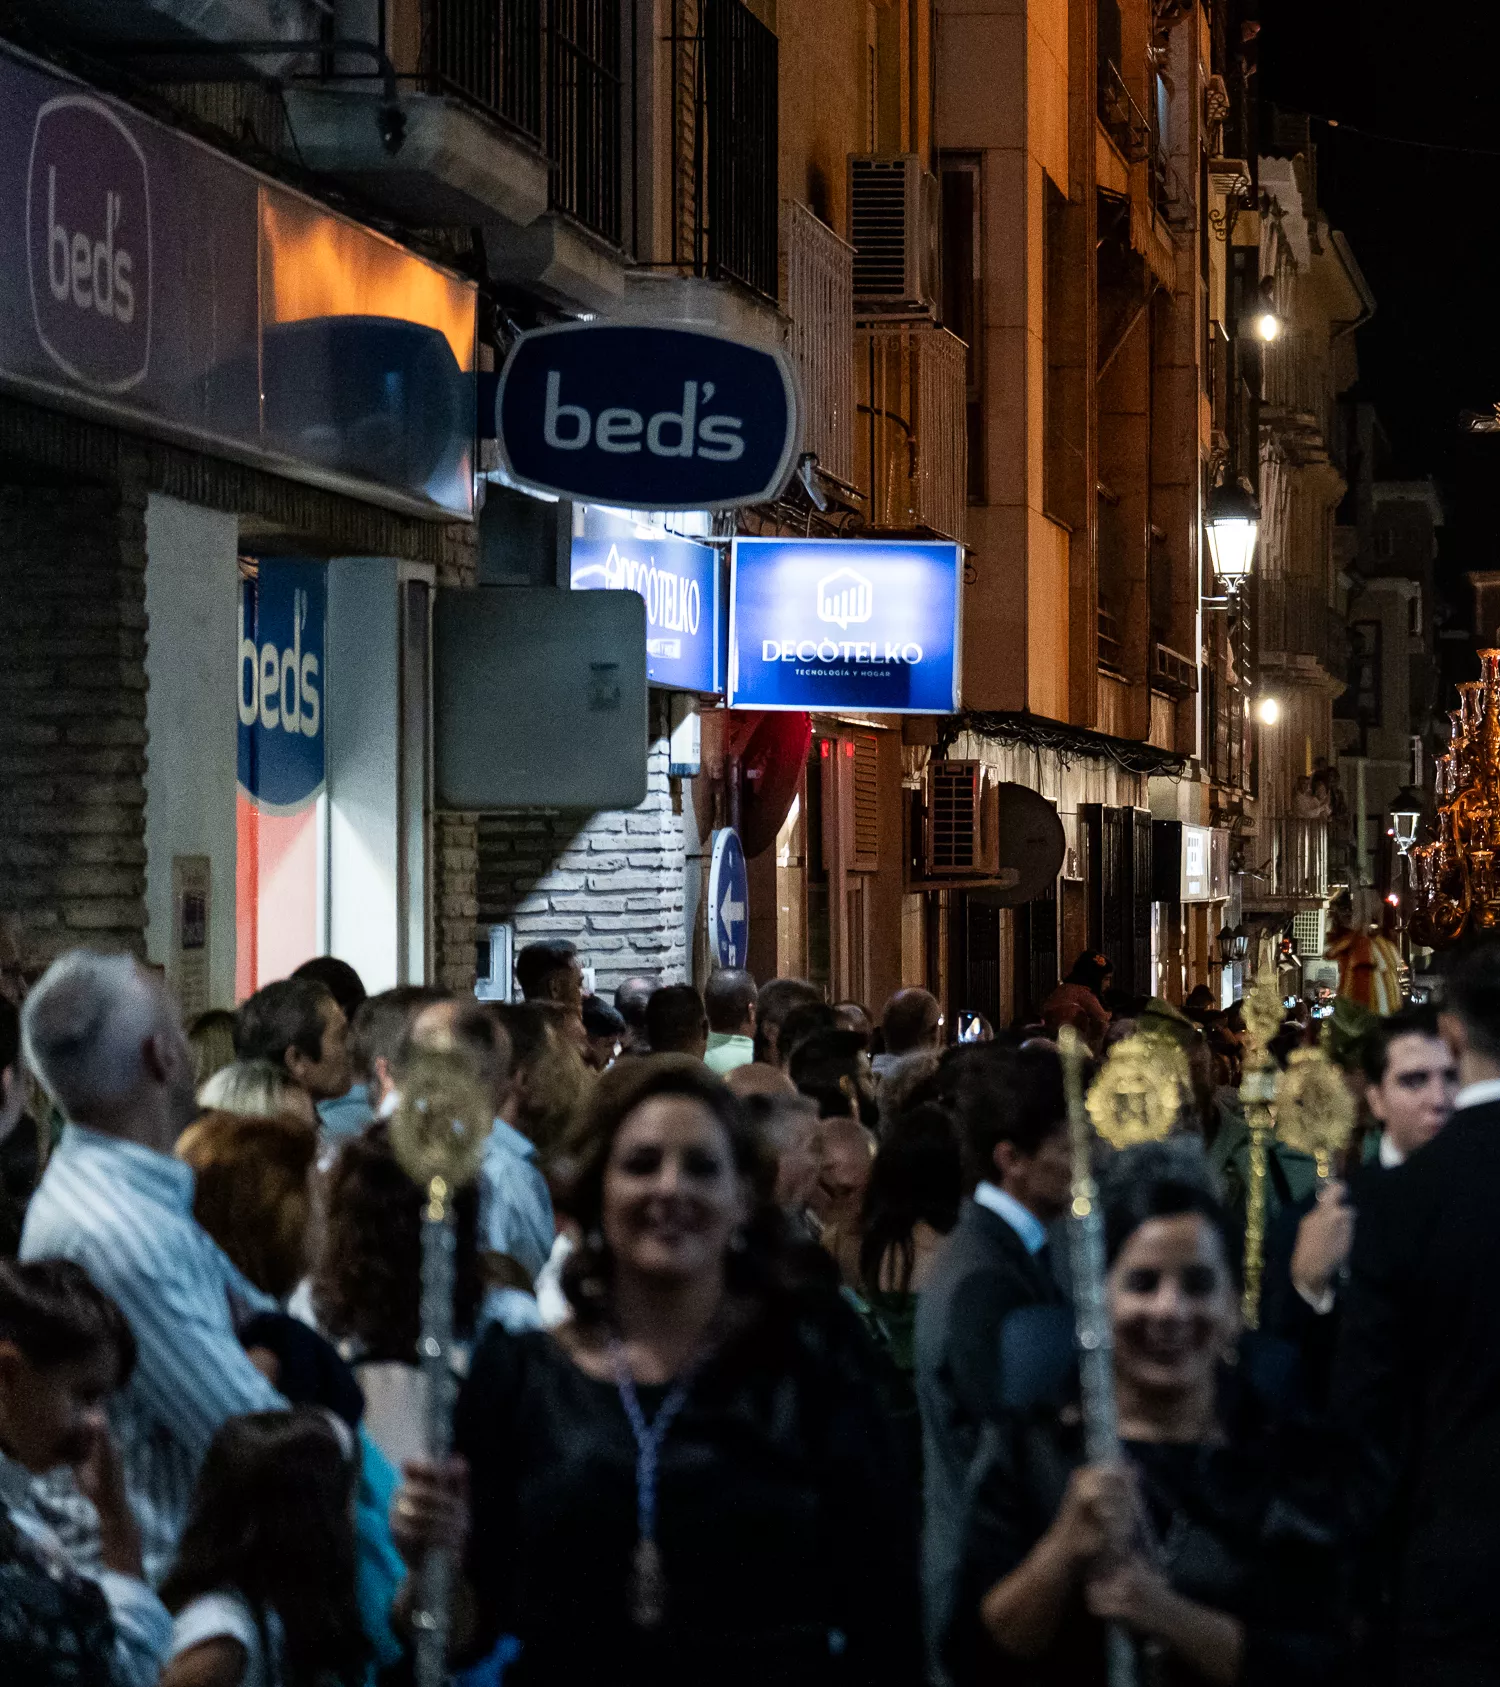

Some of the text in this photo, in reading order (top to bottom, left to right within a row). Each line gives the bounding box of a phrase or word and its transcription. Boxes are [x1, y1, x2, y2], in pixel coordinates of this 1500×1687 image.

[49, 165, 135, 324] bed's
[543, 371, 746, 462] bed's
[795, 667, 850, 677] TECNOLOGÍA
